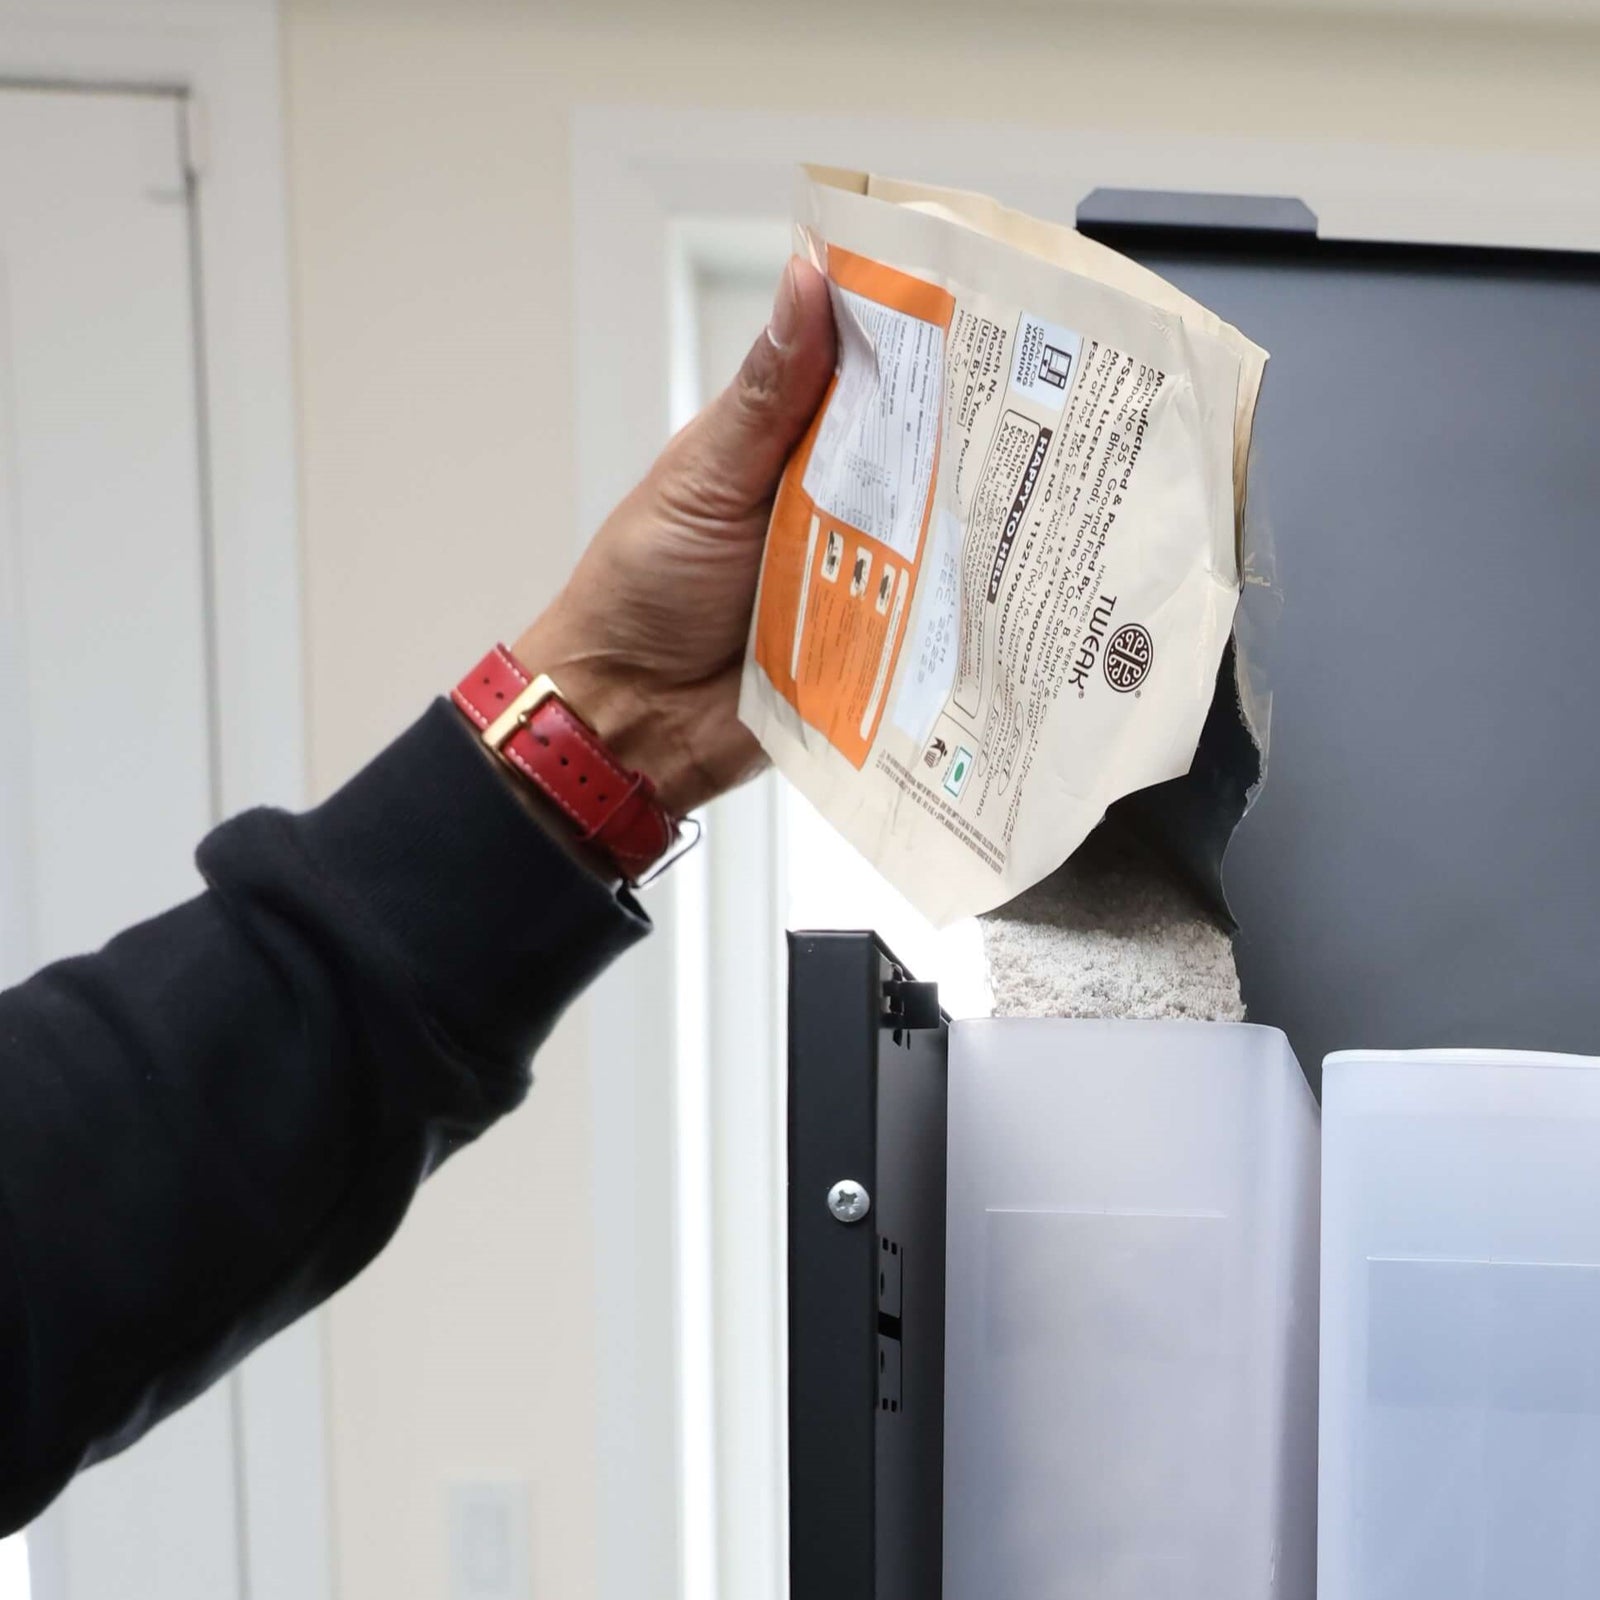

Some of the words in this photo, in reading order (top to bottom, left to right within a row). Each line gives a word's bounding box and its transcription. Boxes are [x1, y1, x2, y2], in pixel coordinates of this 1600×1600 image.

[964, 316, 980, 352] MRP
[974, 324, 989, 354] Use
[981, 325, 999, 377] Month
[992, 329, 1007, 374] Batch
[1015, 322, 1032, 383] MACHINE
[1033, 327, 1045, 361] IDEAL
[967, 359, 980, 380] By
[1021, 325, 1038, 387] VENDING
[1094, 347, 1112, 377] City
[977, 381, 985, 393] &
[984, 379, 997, 406] No.
[1027, 364, 1037, 388] FOR
[1084, 350, 1119, 428] Marketed
[1089, 380, 1099, 395] of
[1108, 356, 1134, 405] FSSAI
[1136, 367, 1156, 405] Gala
[958, 384, 973, 421] Date
[966, 399, 980, 434] Year
[1122, 407, 1138, 436] No.
[1002, 427, 1022, 467] Email
[1078, 408, 1109, 481] LICENSE
[1119, 370, 1165, 490] Manufactured
[1005, 430, 1028, 480] Mobile
[1005, 433, 1035, 502] Customer
[1016, 436, 1047, 508] HAPPY
[1086, 431, 1120, 507] Bhiwandi,
[1113, 441, 1130, 468] 55,
[1089, 476, 1117, 536] Ground
[1112, 493, 1123, 507] &
[993, 505, 1008, 540] Care
[1004, 509, 1020, 538] TO
[1035, 509, 1058, 564] Mulund
[1067, 510, 1093, 562] Thane,
[1071, 539, 1094, 580] Floor,
[1087, 512, 1115, 572] Packed
[988, 541, 1009, 594] HELP
[1060, 584, 1075, 613] Om
[1073, 575, 1090, 601] By:
[1078, 564, 1106, 623] HAPPINESS
[1067, 605, 1078, 621] C.
[1072, 625, 1082, 638] IN
[1040, 617, 1063, 674] Sainath
[1046, 644, 1063, 683] Shah
[1059, 641, 1075, 673] EVERY
[1050, 675, 1063, 699] CUP
